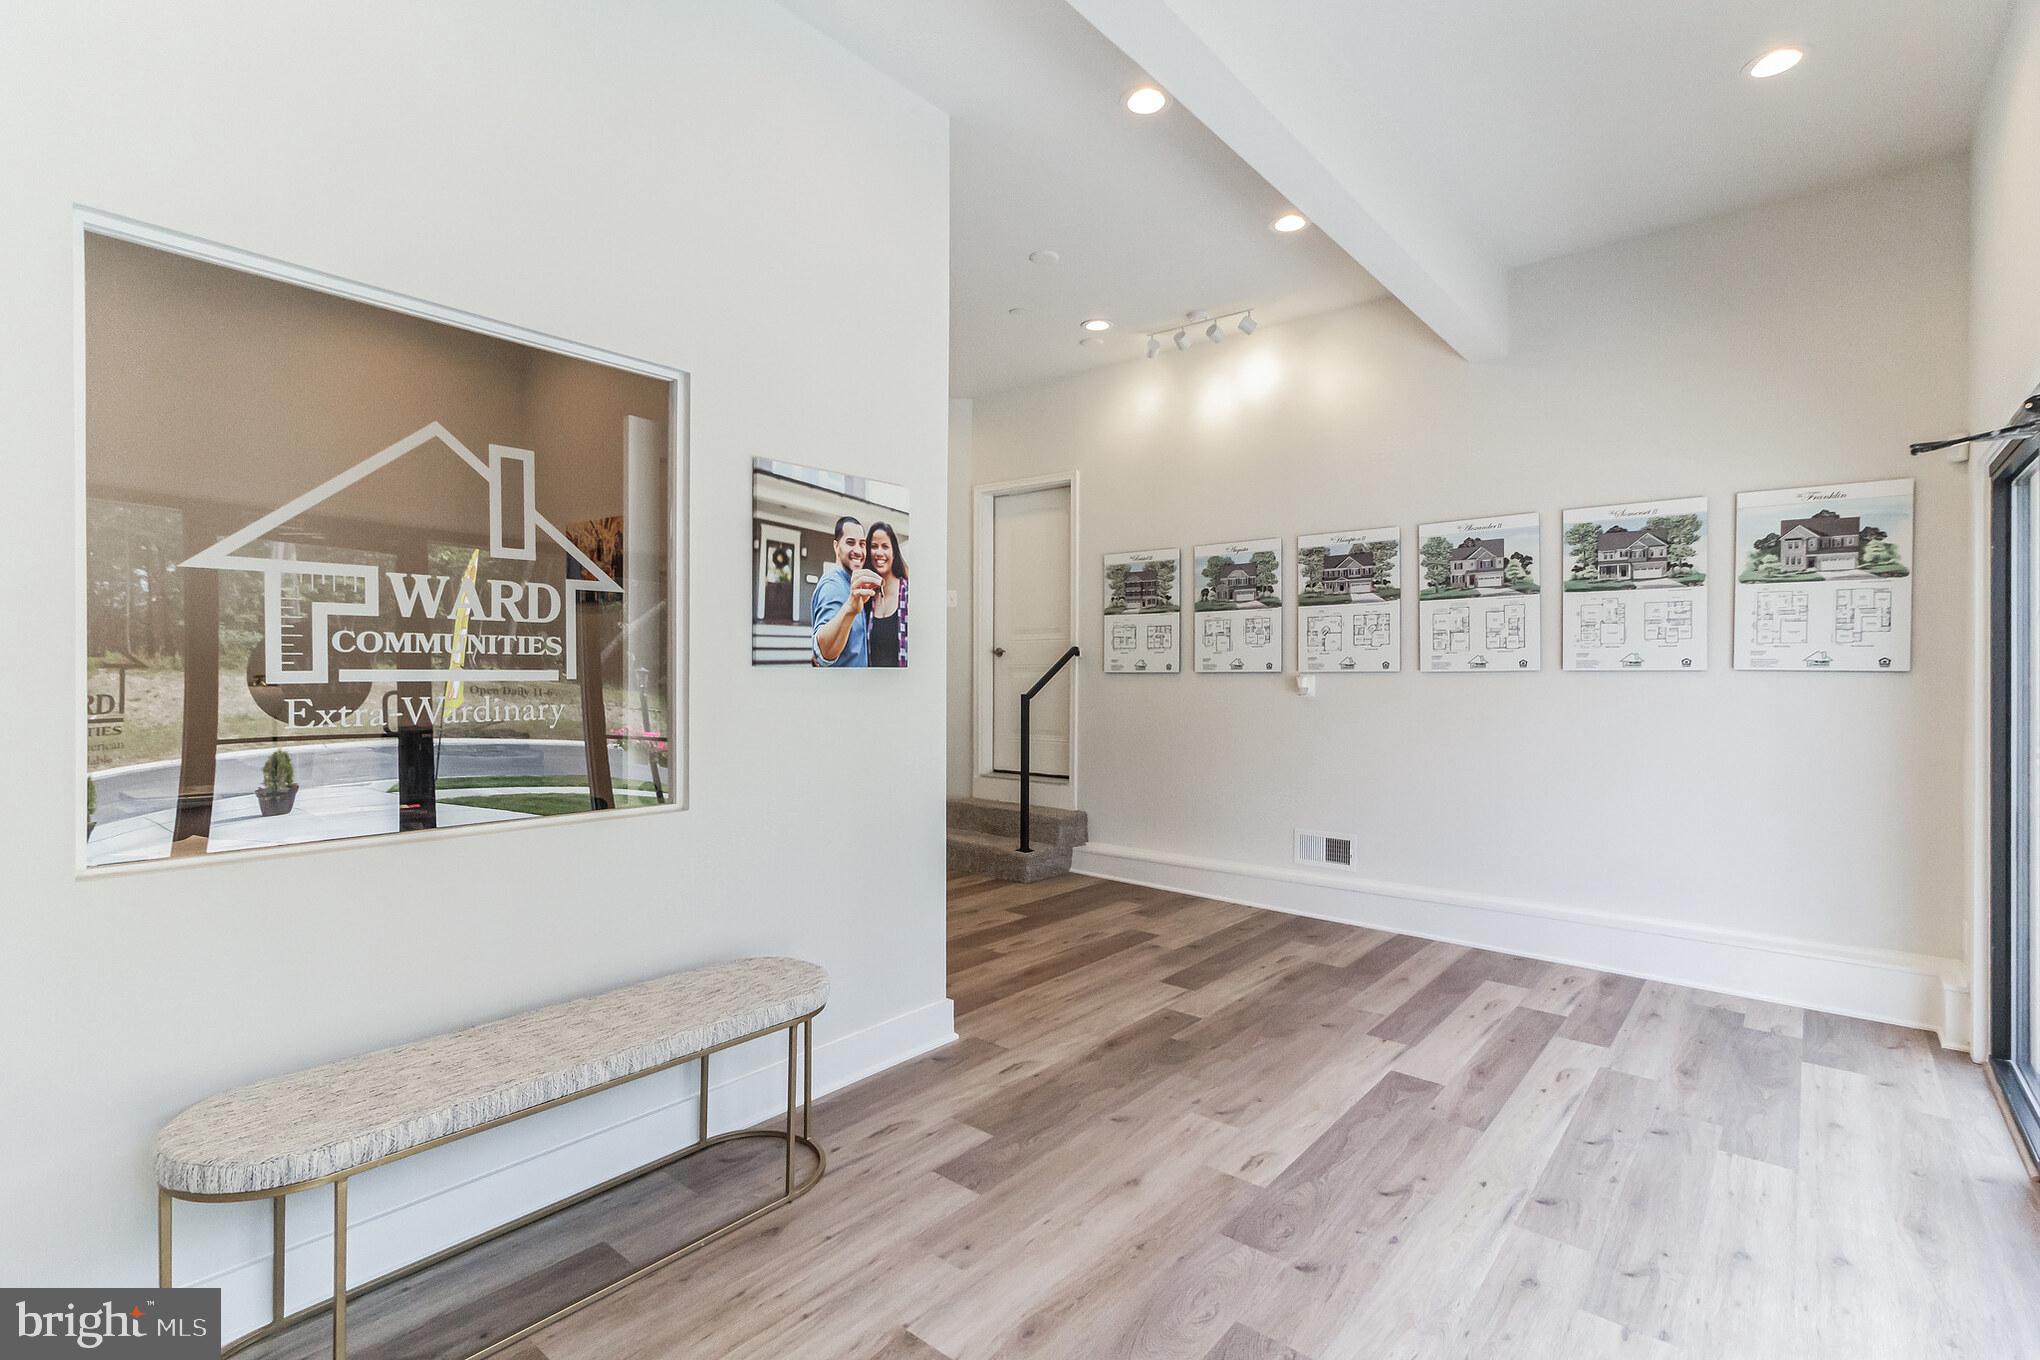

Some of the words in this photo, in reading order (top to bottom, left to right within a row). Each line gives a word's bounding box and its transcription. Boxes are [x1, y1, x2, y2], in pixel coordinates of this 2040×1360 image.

[385, 572, 561, 624] WARD
[331, 630, 563, 656] COMMUNITIES
[469, 685, 499, 697] Open
[503, 686, 529, 698] Daily
